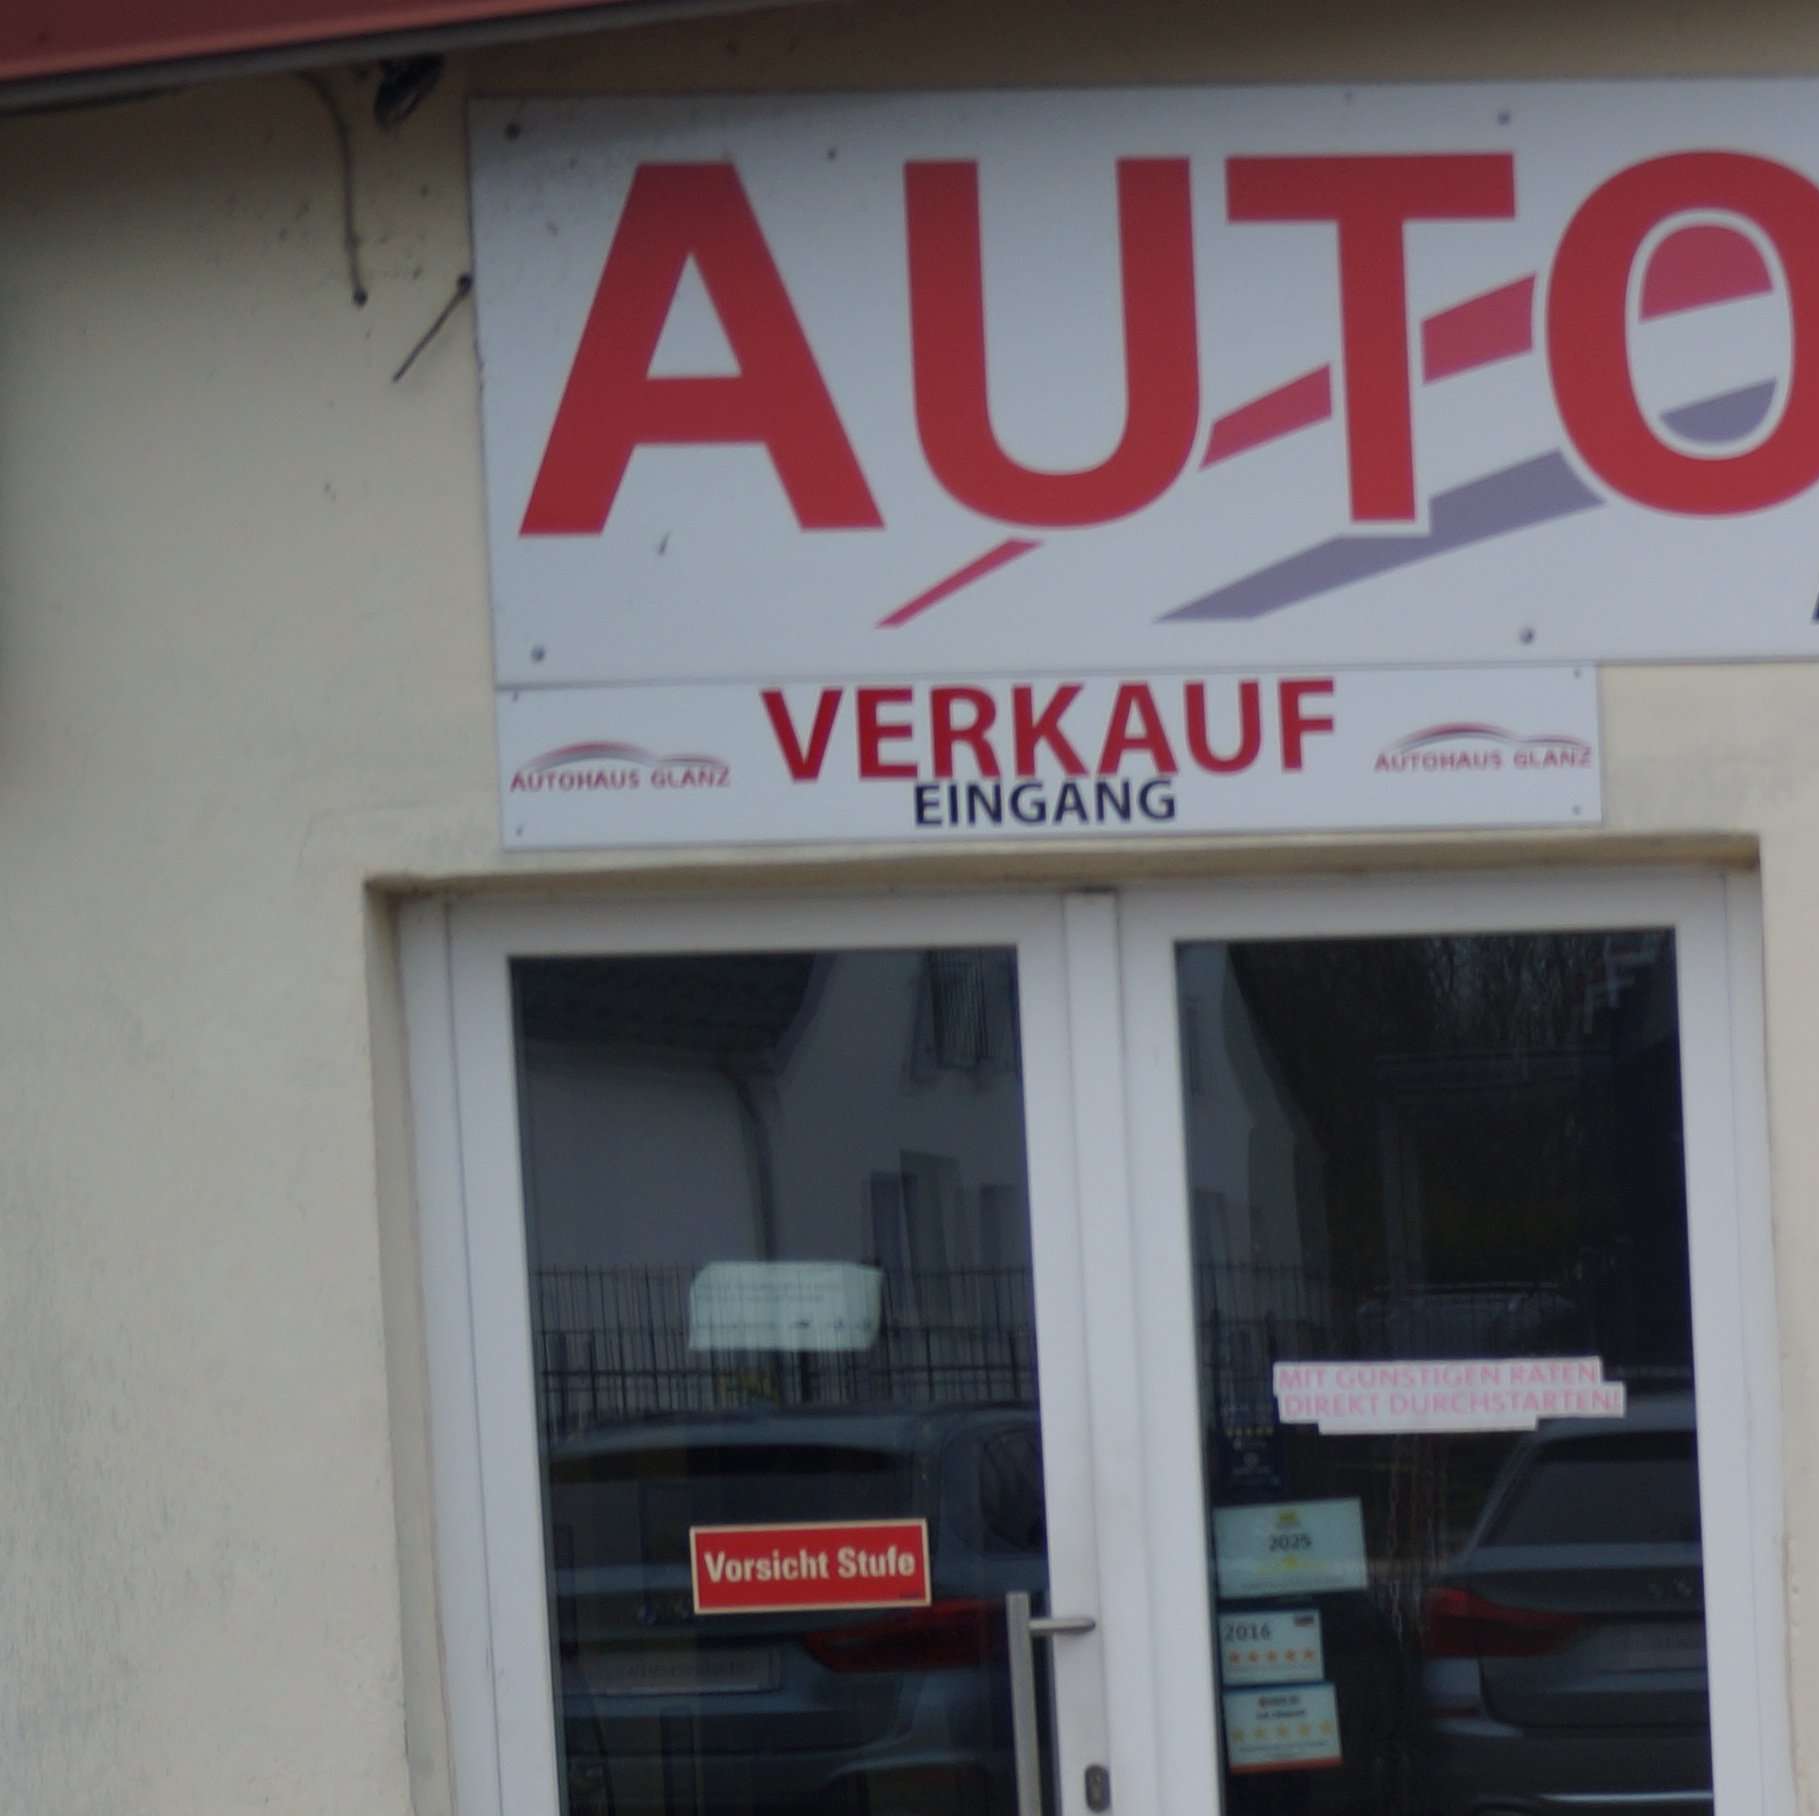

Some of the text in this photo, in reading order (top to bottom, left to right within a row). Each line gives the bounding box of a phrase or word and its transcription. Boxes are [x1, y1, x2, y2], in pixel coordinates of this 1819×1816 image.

[762, 680, 1335, 781] VERKAUF
[1373, 745, 1593, 773] AUTOHAUS GLANZ
[509, 765, 732, 793] AUTOHAUS GLANZ
[913, 778, 1177, 826] EINGANG
[1278, 1367, 1325, 1390] MIT
[1508, 1362, 1600, 1385] RATEN
[1283, 1388, 1621, 1417] DIREKT DURCHSTARTEN!
[703, 1544, 917, 1584] Vorsicht Stufe
[1223, 1622, 1271, 1642] 2016
